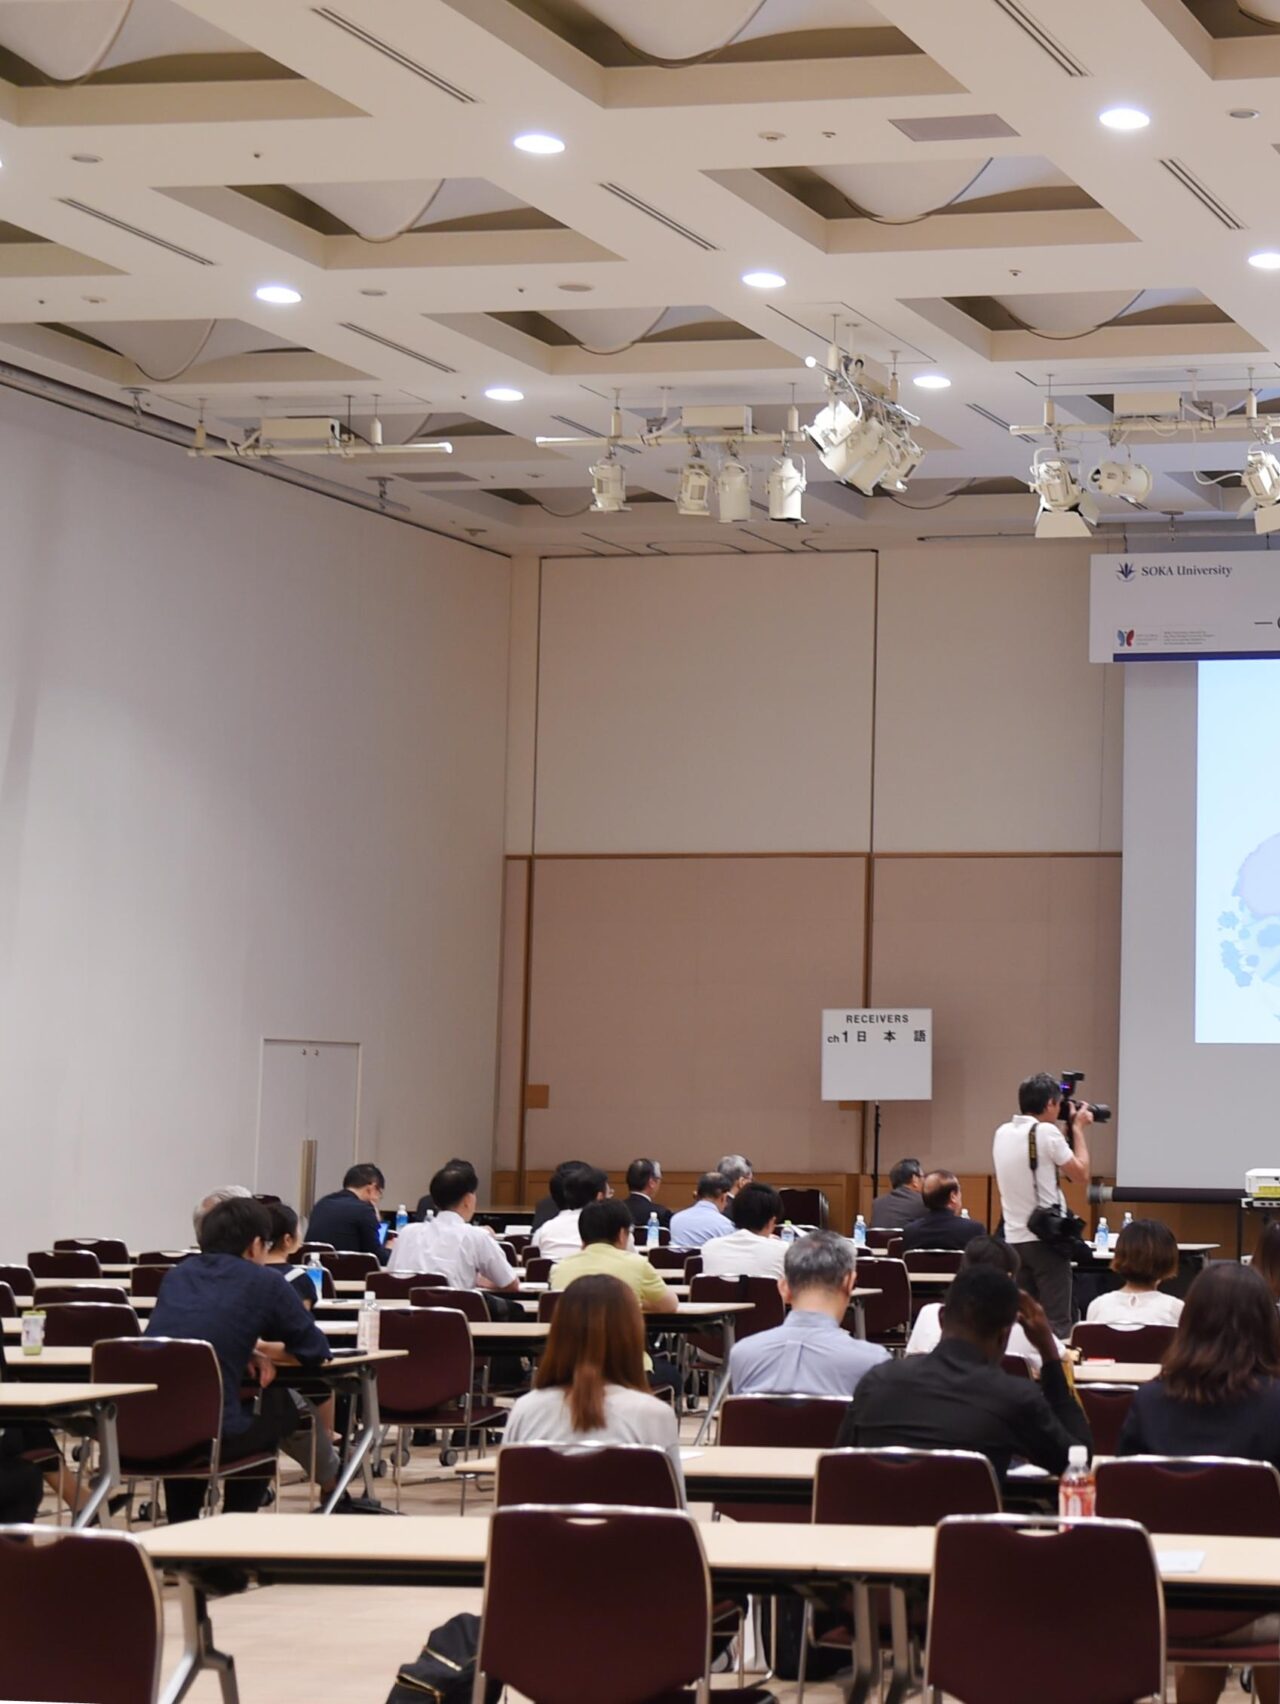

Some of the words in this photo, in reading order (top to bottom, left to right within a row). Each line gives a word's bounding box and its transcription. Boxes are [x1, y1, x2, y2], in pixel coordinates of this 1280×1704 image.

[1141, 566, 1173, 576] SOKA
[1177, 565, 1232, 578] University
[846, 1014, 909, 1024] RECEIVERS
